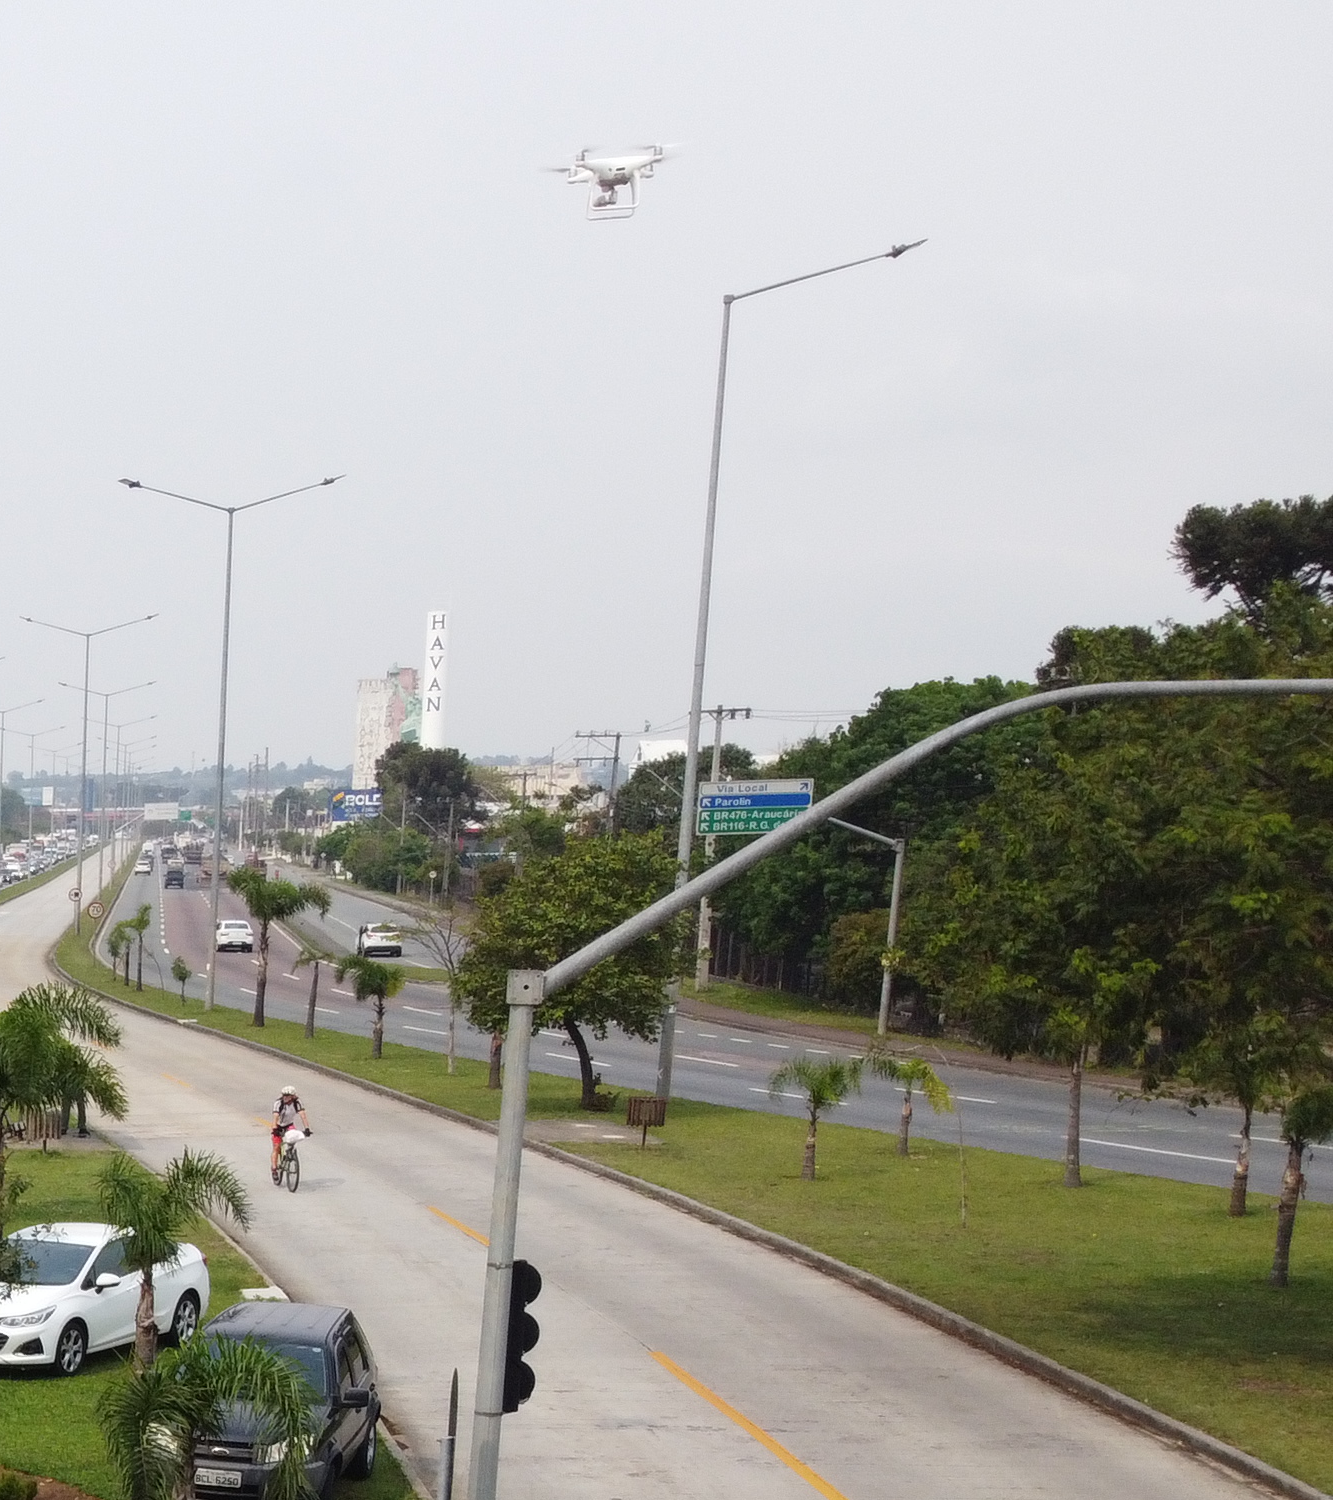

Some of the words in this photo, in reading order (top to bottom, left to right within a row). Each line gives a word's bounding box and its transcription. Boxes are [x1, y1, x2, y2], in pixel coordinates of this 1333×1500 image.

[426, 614, 446, 712] HAVAN
[717, 785, 733, 793] Via
[738, 783, 768, 793] Local
[714, 798, 752, 806] Parolin
[91, 905, 101, 914] 70
